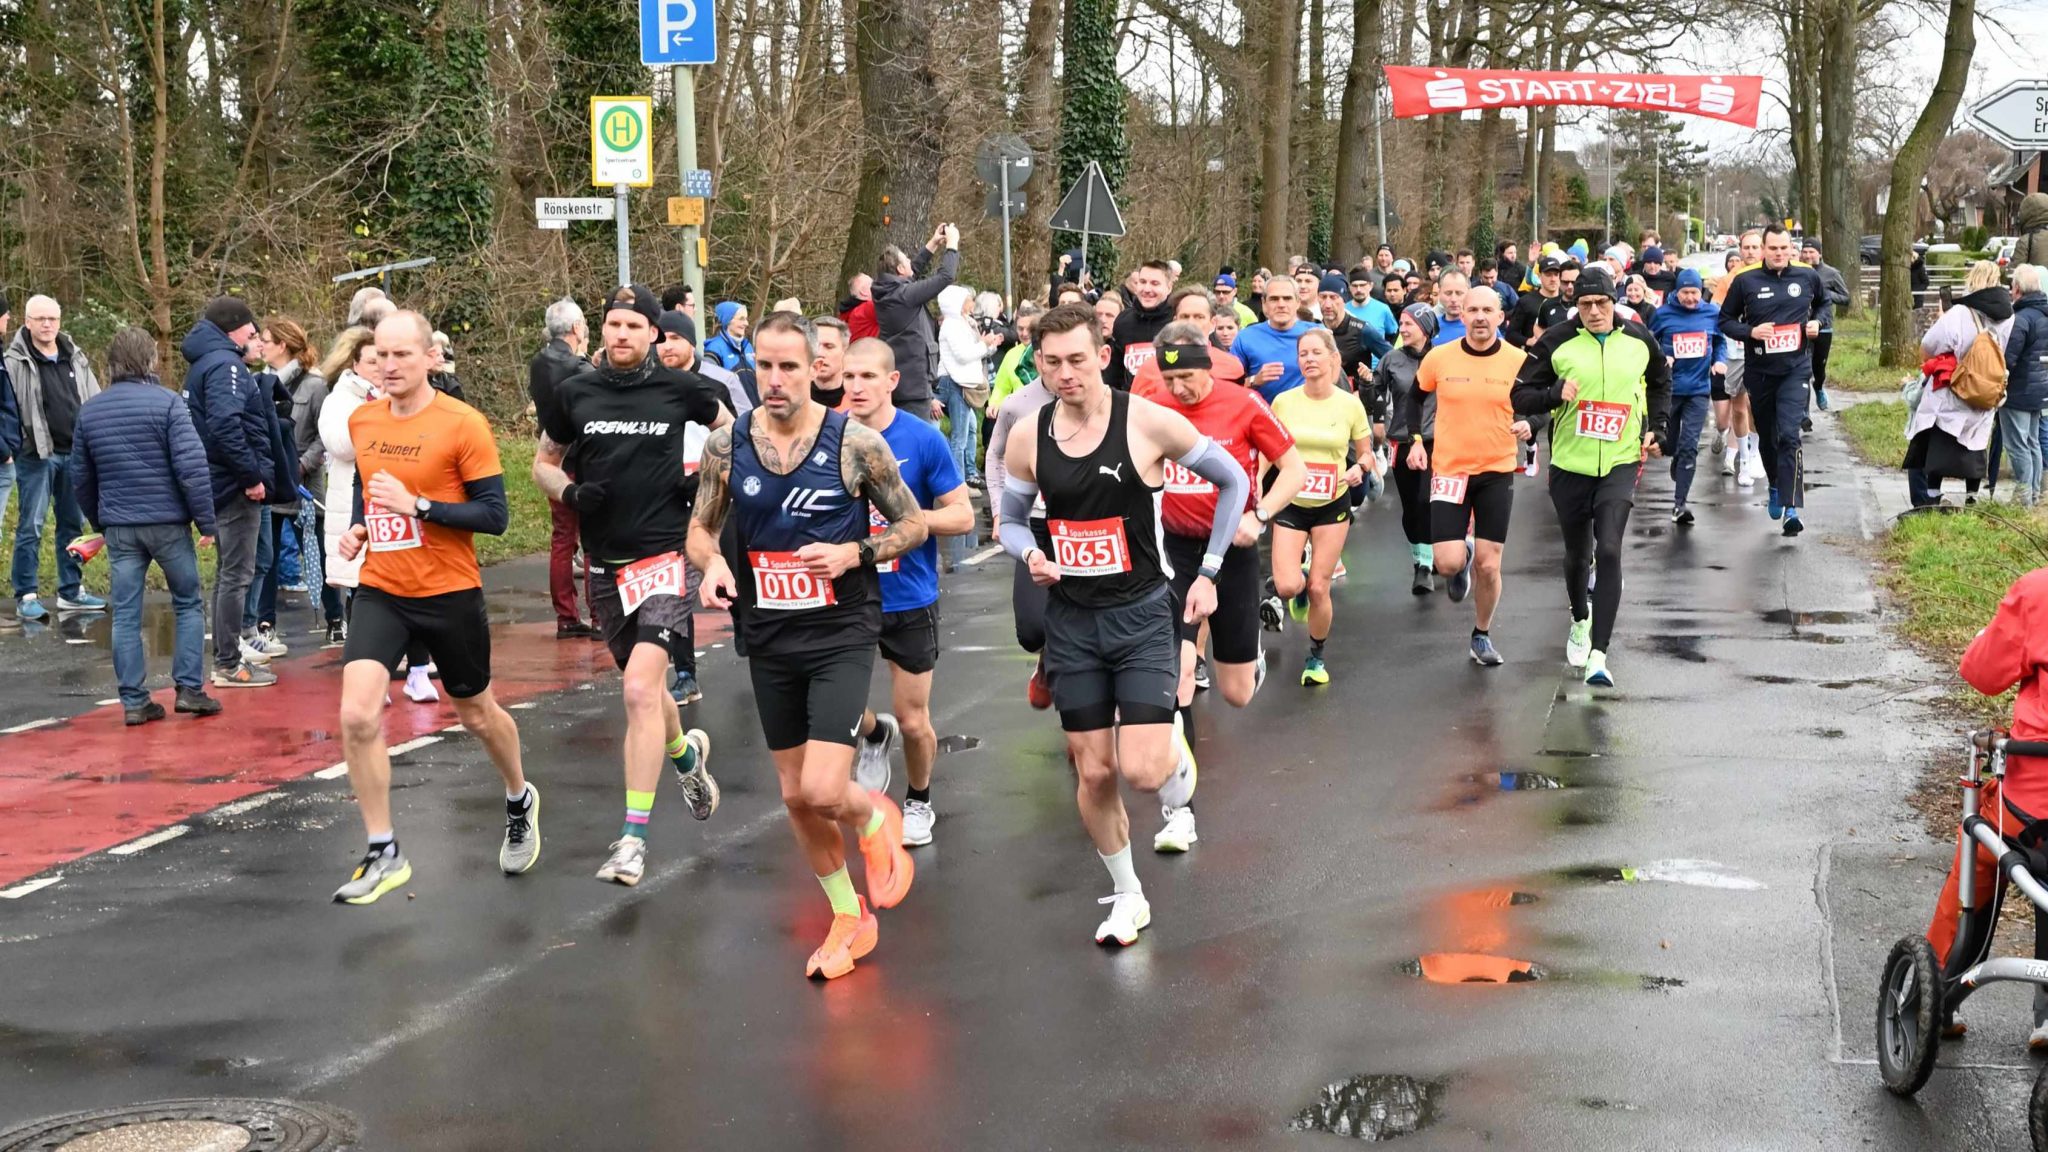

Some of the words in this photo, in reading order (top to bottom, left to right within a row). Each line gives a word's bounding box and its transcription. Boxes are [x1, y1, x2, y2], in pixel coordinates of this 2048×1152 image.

[657, 0, 697, 54] P
[612, 116, 630, 142] H
[544, 202, 603, 215] Rönskenstr.
[1677, 341, 1702, 354] 006
[1586, 413, 1619, 434] 186
[380, 441, 421, 457] bunert
[368, 517, 407, 542] 189
[1069, 528, 1108, 538] Sparkasse
[770, 560, 805, 568] Sparkass
[1061, 540, 1112, 567] 065
[765, 572, 812, 599] 010
